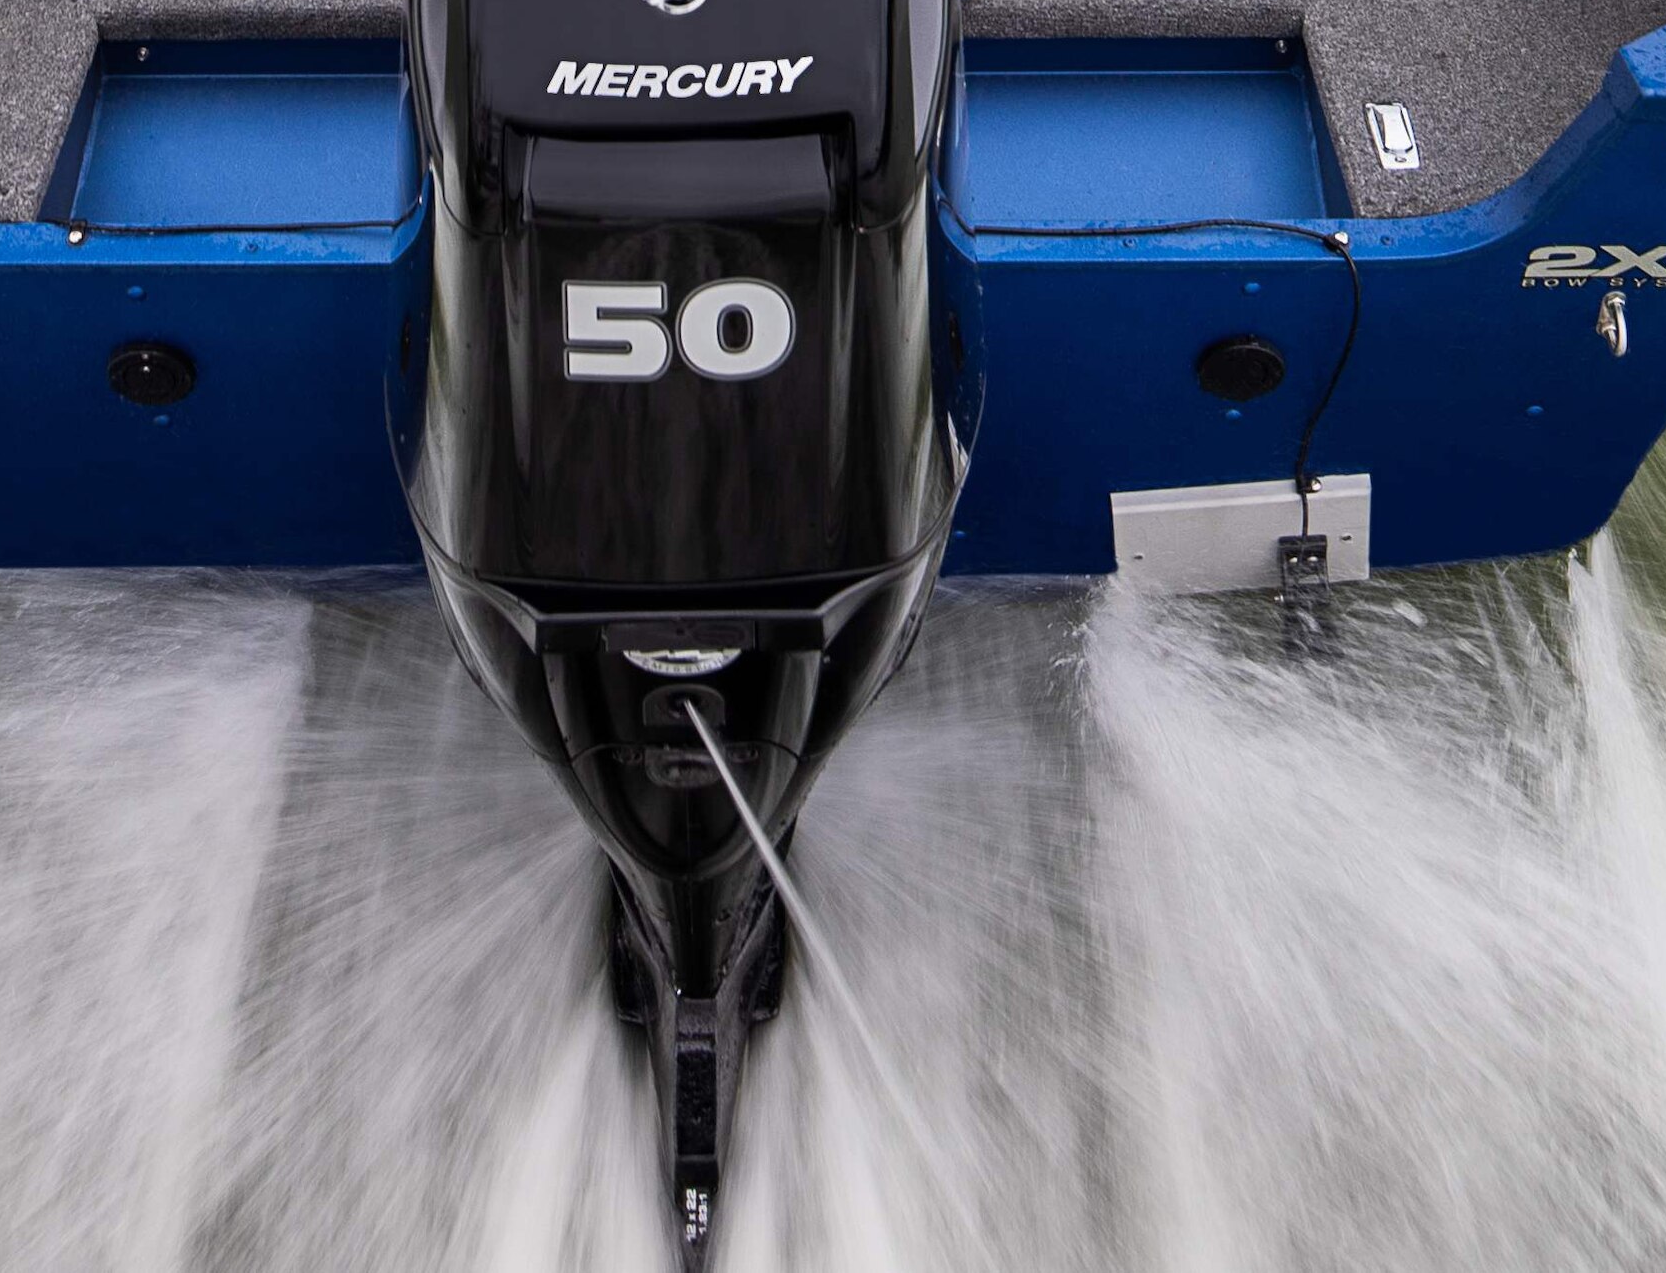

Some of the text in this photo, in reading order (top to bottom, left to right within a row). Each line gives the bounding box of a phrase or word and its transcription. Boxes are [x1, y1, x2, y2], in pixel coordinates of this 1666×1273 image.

[546, 56, 813, 98] MERCURY
[1521, 277, 1588, 287] BOW
[562, 277, 796, 382] 50
[686, 1188, 697, 1211] 22
